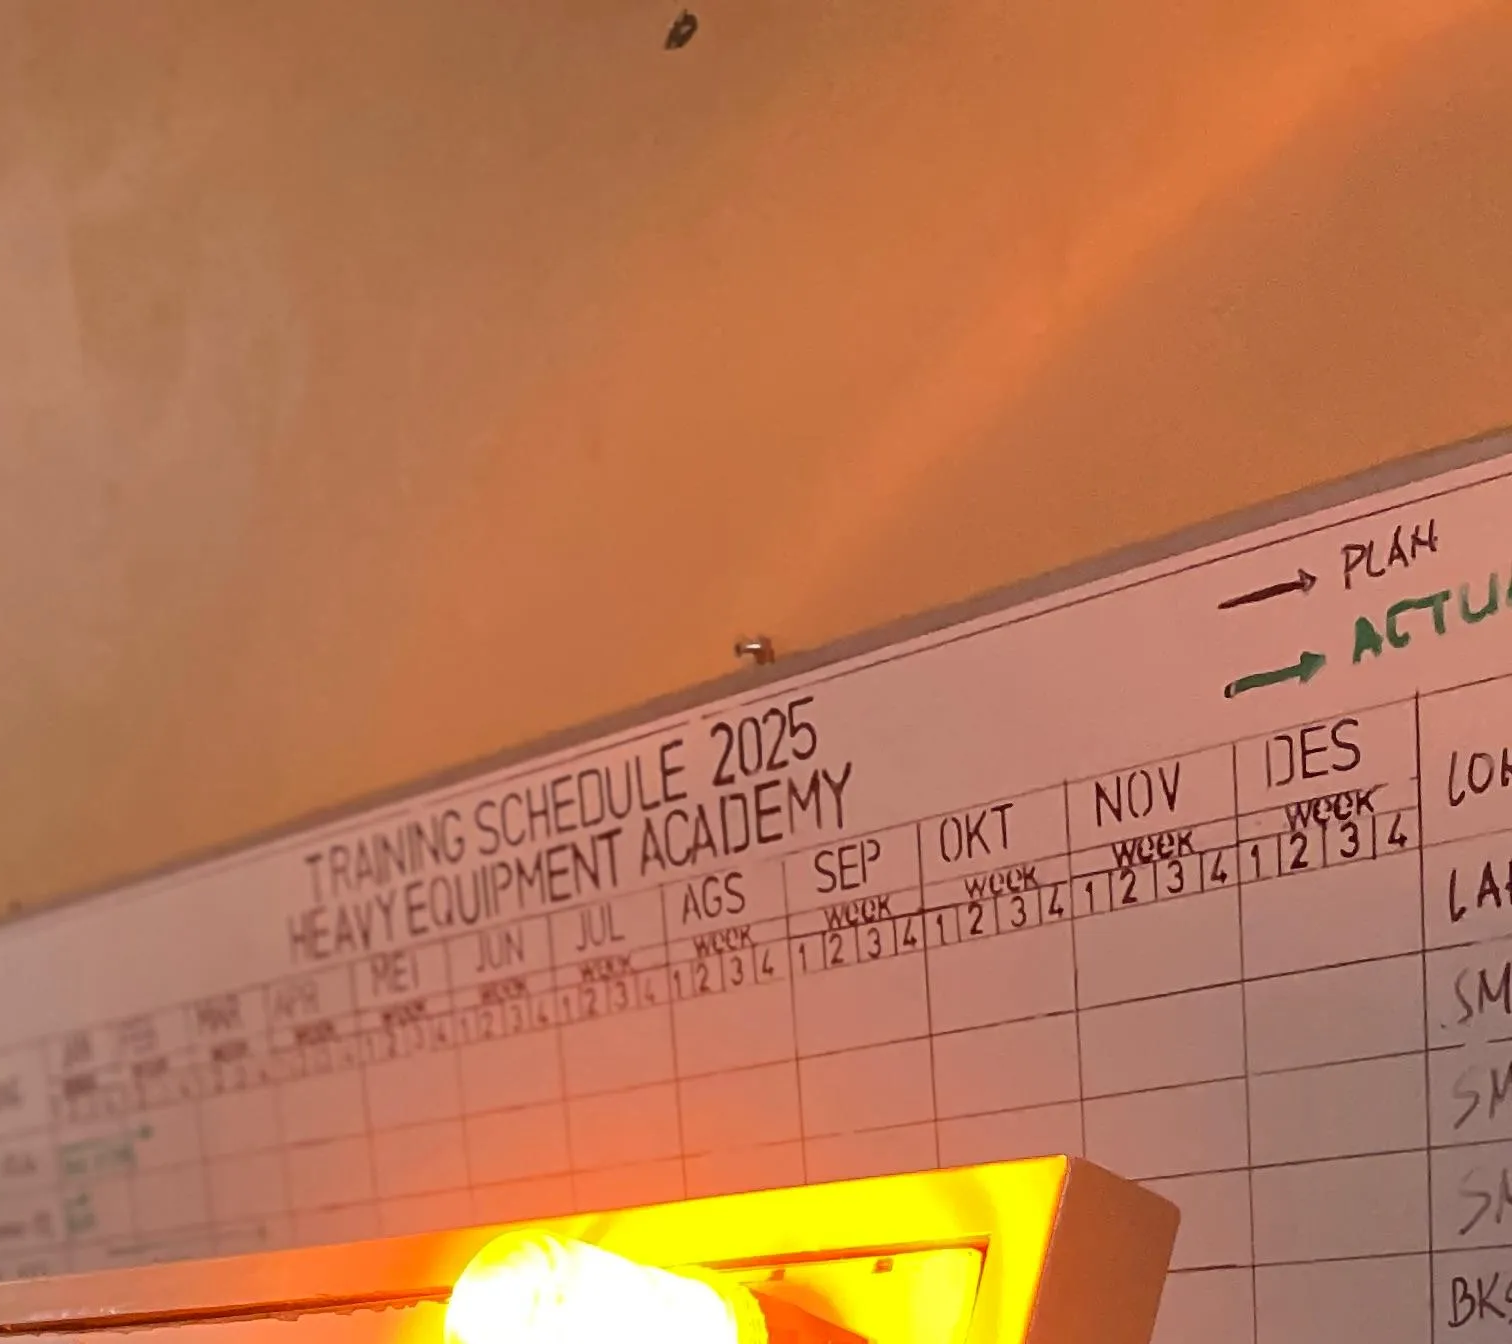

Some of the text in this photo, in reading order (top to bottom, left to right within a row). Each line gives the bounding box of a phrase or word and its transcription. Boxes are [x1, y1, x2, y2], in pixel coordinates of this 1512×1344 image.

[1341, 518, 1439, 590] PLAN
[1352, 572, 1512, 664] ACTU
[305, 696, 818, 902] TRAINING SCHEDULE 2025
[289, 762, 853, 962] HEAVY EQUIPMENT ACADEMY
[371, 951, 420, 996] MEI
[477, 927, 525, 973] JUN
[577, 904, 625, 951] JUL
[682, 872, 746, 925] AGS
[814, 839, 881, 895] SEP
[940, 803, 1015, 863] OKT
[1094, 762, 1181, 828] NOV
[1266, 718, 1362, 788] DES
[1121, 872, 1139, 905] 2
[1168, 861, 1186, 895] 3
[1211, 851, 1229, 885] 4
[1250, 812, 1409, 878] 1 2 3 4
[968, 902, 985, 937] 2
[1009, 896, 1028, 930] 3
[1047, 885, 1067, 919] 4
[1448, 860, 1512, 923] LA
[695, 963, 712, 994] 2
[728, 957, 745, 987] 3
[760, 949, 776, 979] 4
[829, 933, 846, 965] 2
[866, 927, 883, 960] 3
[901, 914, 919, 948] 4
